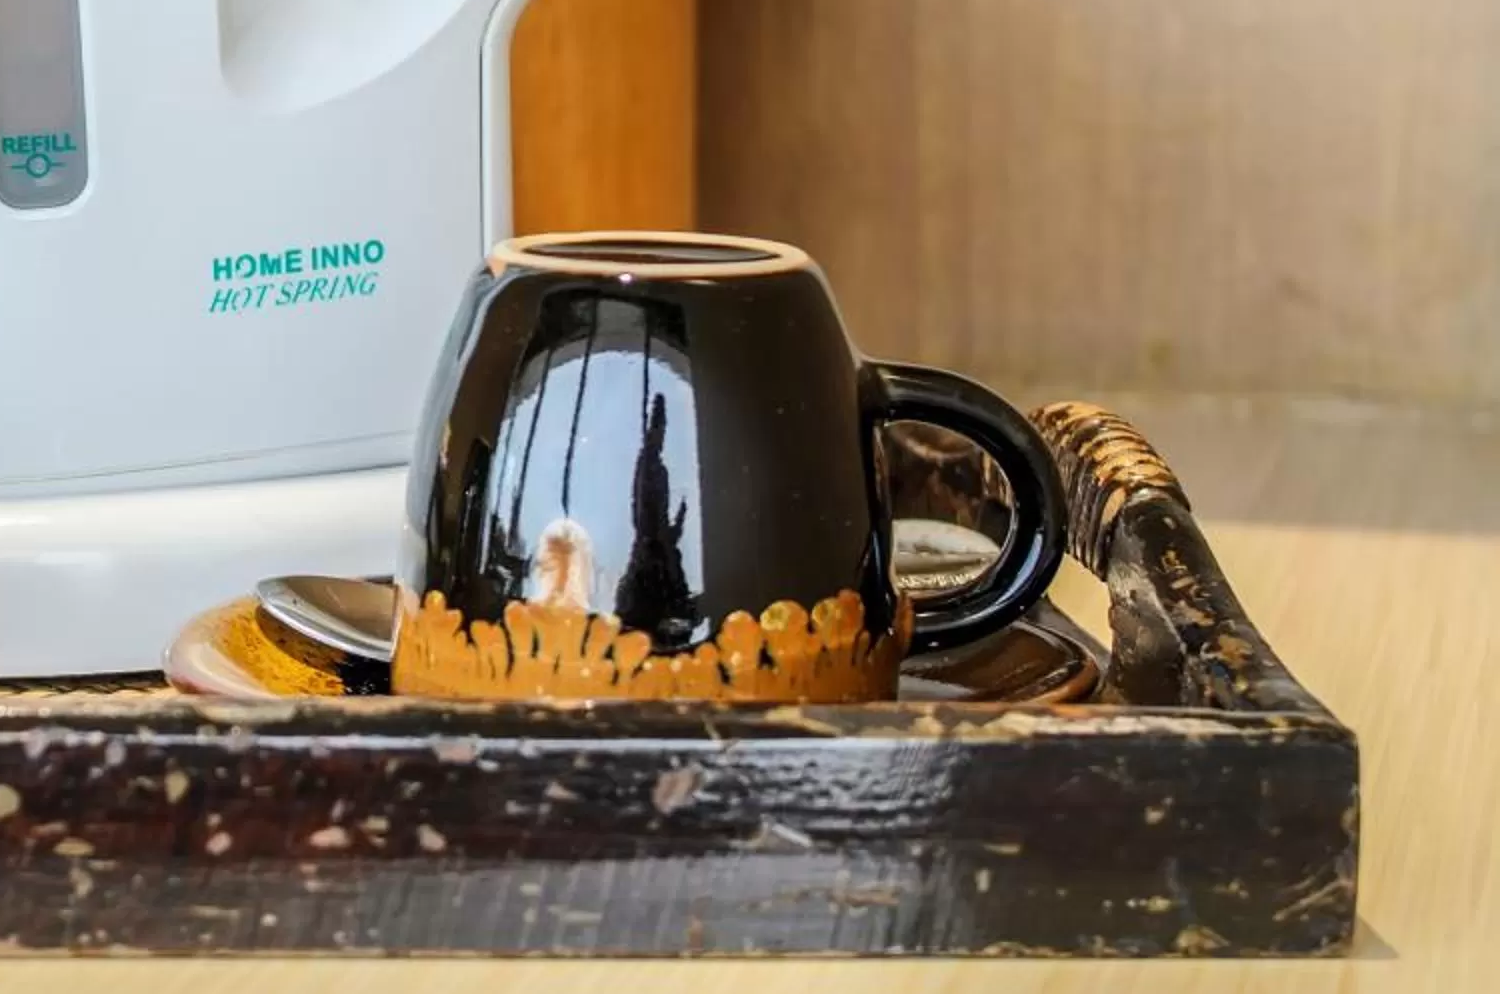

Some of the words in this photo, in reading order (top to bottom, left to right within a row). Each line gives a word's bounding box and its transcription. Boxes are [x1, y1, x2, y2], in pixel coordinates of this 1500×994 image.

[2, 133, 77, 154] REFILL
[213, 249, 303, 282] HOME
[311, 239, 385, 271] INNO
[209, 283, 275, 313] HOT
[275, 271, 379, 306] SPRING
